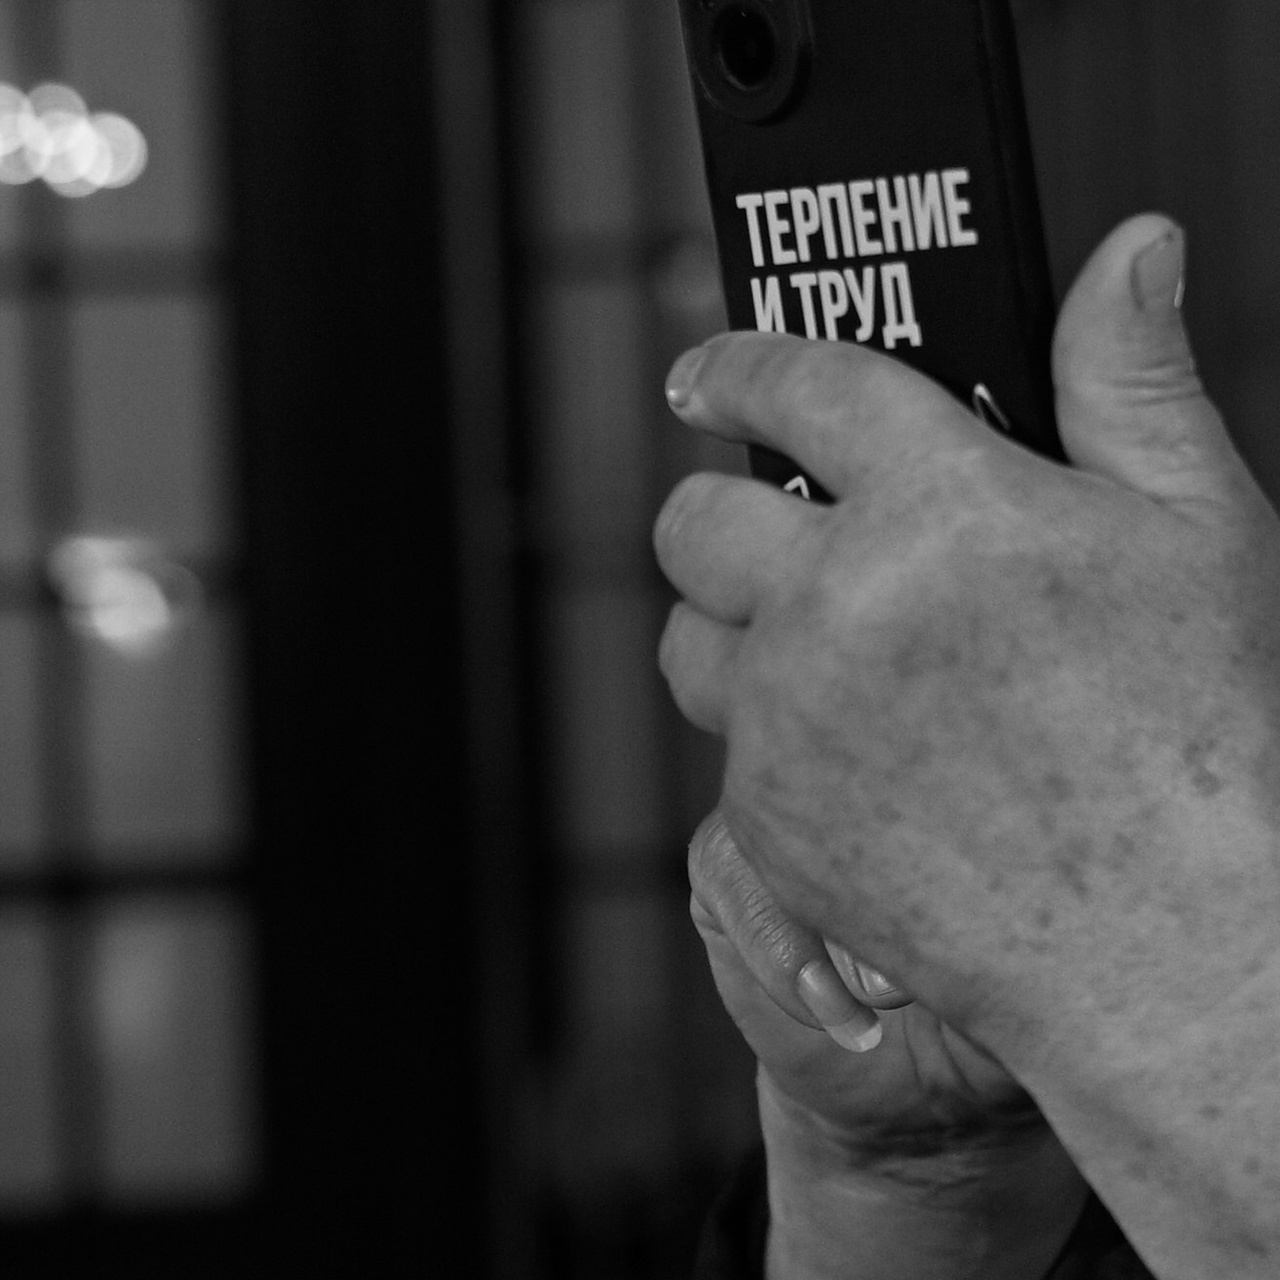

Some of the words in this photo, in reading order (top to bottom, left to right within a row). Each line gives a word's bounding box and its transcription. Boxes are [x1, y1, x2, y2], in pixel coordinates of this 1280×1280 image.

[735, 167, 979, 267] ТЕРПЕНИЕ
[750, 275, 787, 333] И
[789, 261, 923, 349] ТРУД
